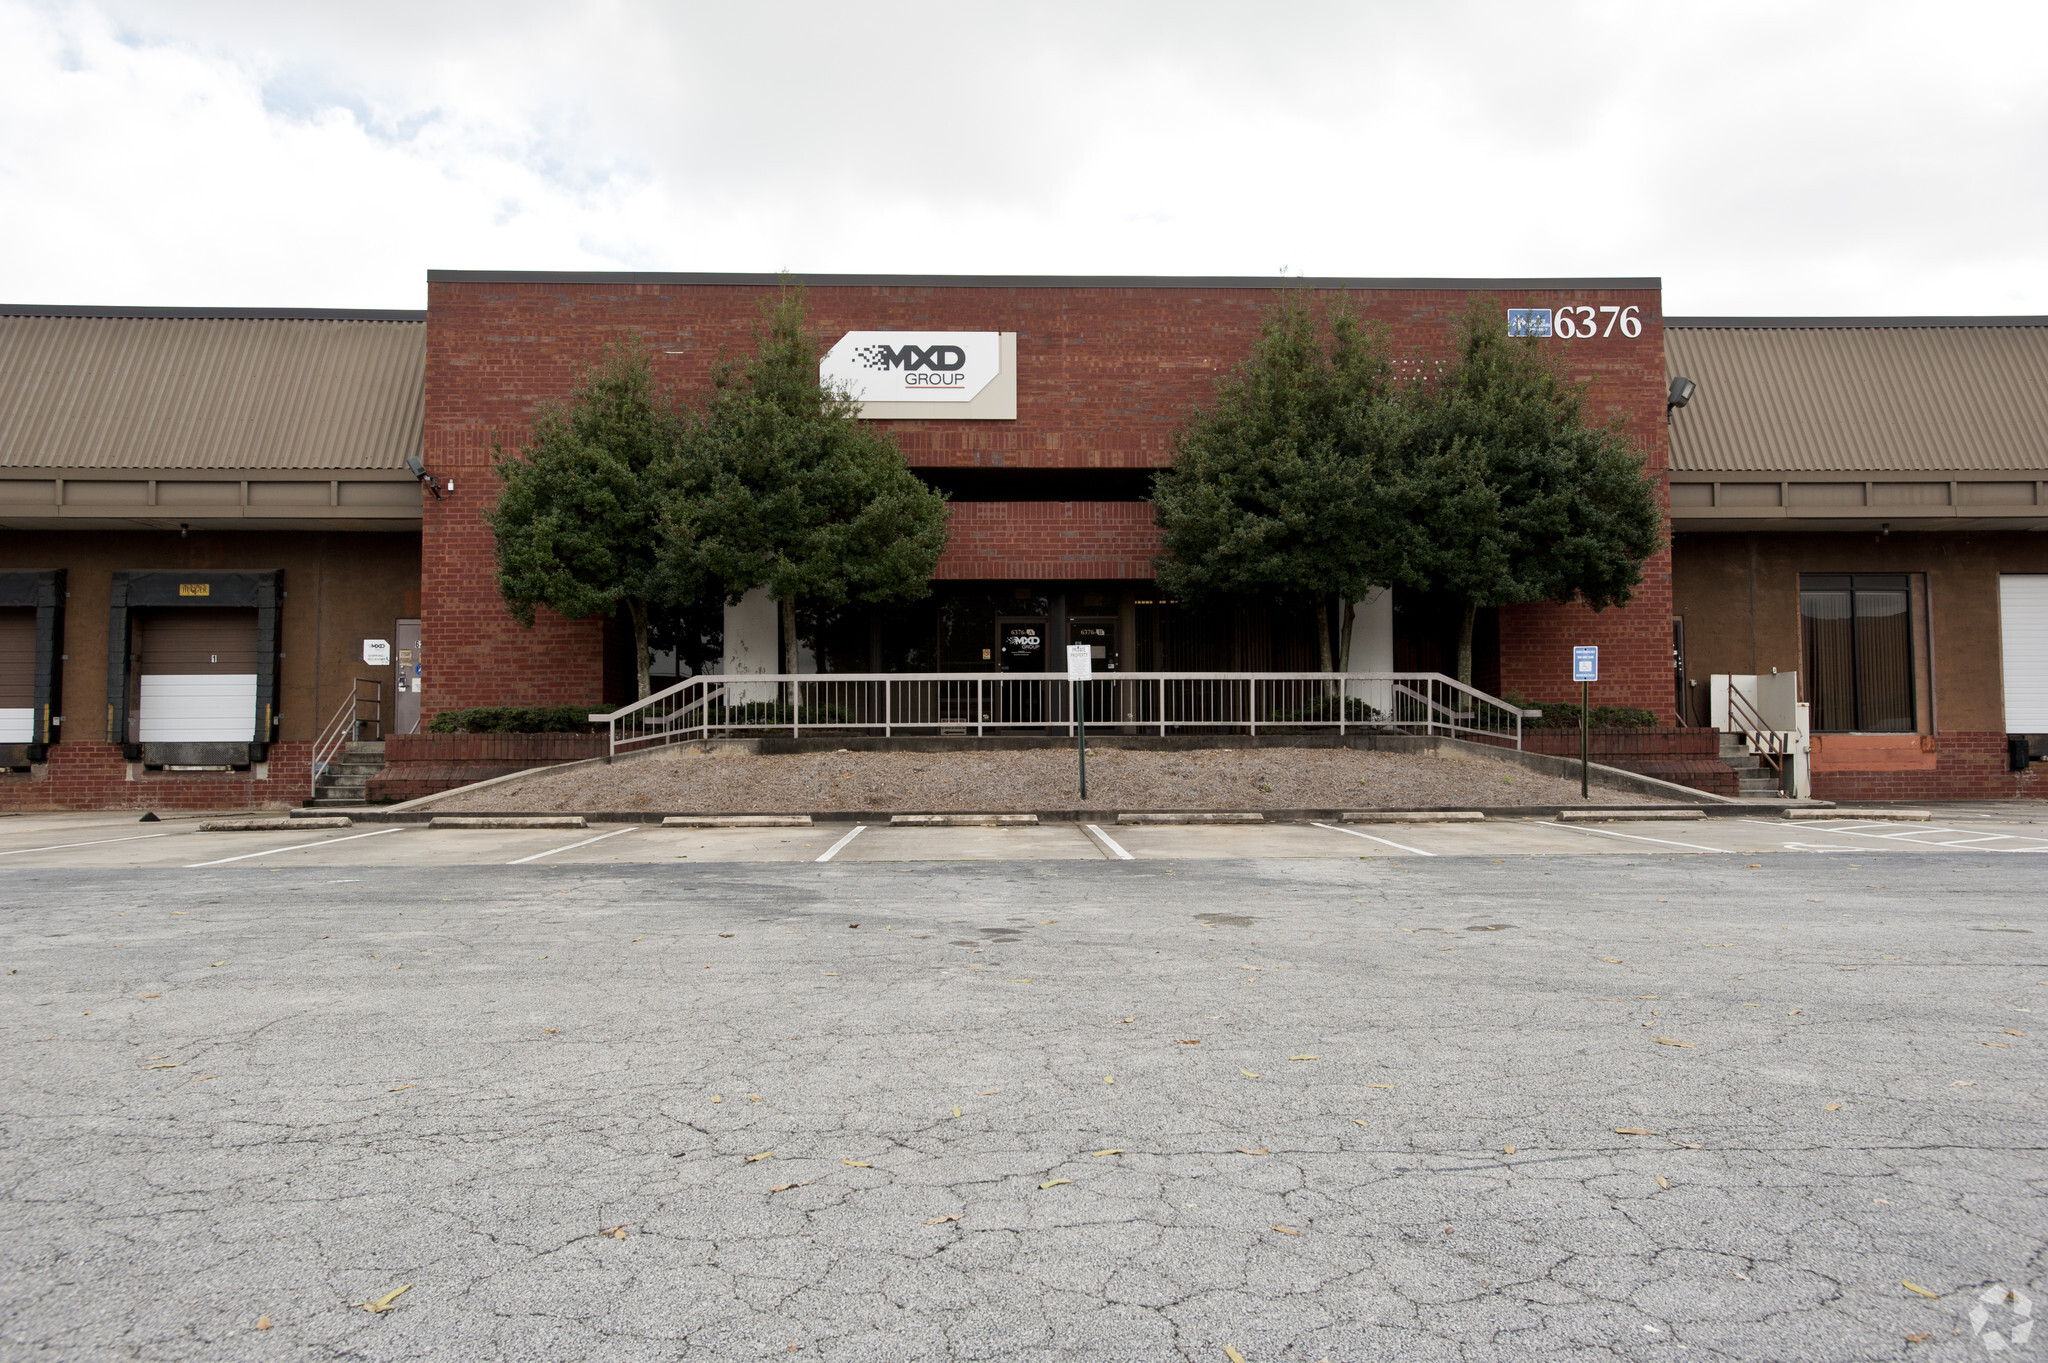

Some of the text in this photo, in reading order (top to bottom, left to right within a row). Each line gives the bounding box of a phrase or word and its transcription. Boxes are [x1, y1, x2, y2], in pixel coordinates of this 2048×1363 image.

[1554, 306, 1642, 339] 6376
[878, 344, 967, 371] MXD
[905, 373, 965, 385] GROUP
[1014, 636, 1040, 645] MXD
